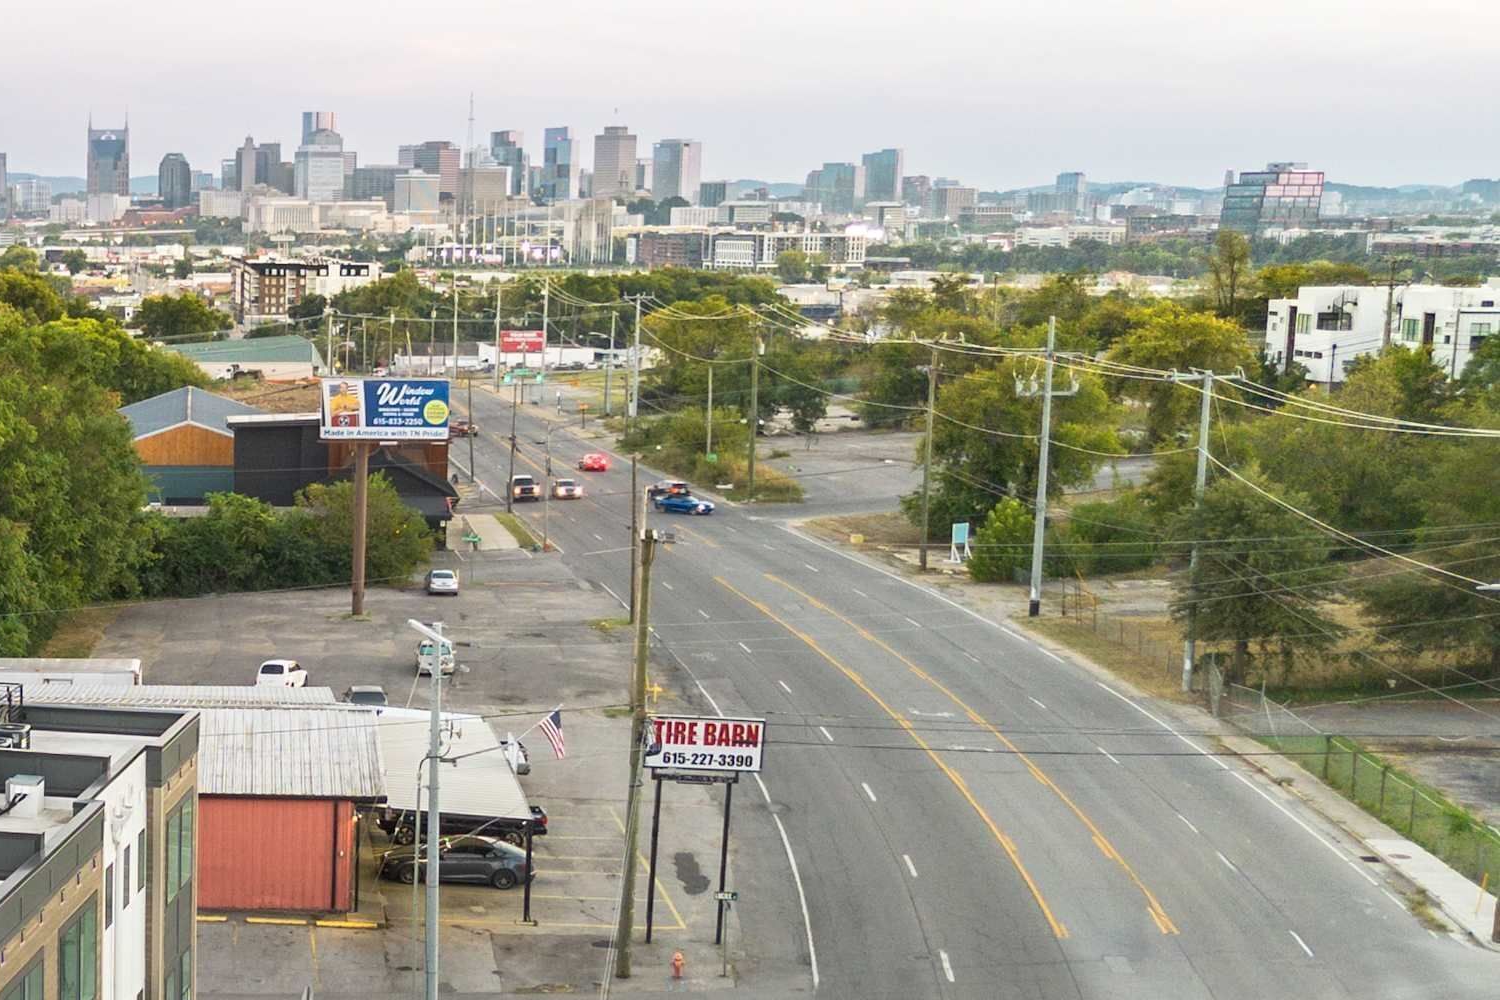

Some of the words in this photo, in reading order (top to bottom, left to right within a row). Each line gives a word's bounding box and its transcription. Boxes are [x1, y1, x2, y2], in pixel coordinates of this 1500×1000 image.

[377, 382, 434, 404] Window
[653, 721, 698, 745] TIRE
[704, 723, 760, 748] BARN
[662, 752, 753, 767] 615-227-3390
